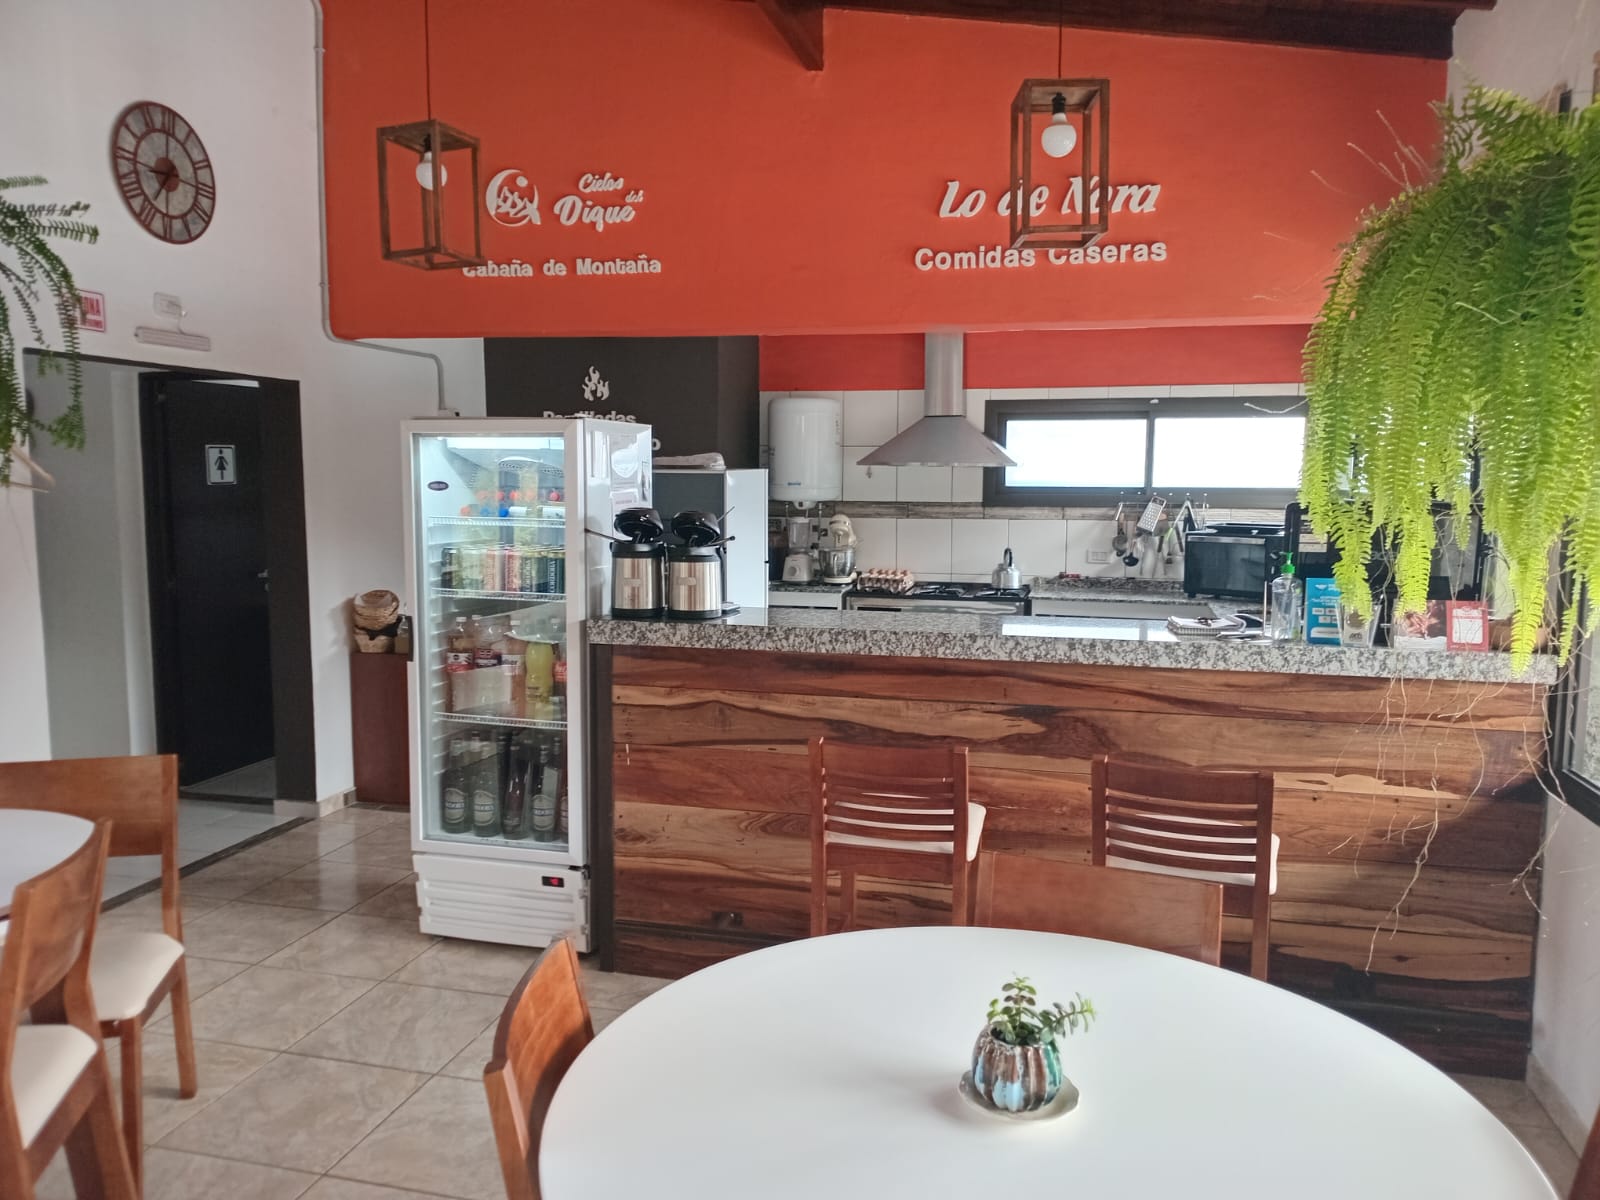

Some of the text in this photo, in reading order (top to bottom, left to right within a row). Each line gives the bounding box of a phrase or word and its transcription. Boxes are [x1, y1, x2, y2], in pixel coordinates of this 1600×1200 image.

[579, 172, 624, 193] Cielos
[939, 175, 1161, 218] Lo de Nra
[553, 195, 636, 232] Dique
[463, 254, 662, 277] Cabaña de Montaña
[915, 241, 1167, 271] Comidas Caseras
